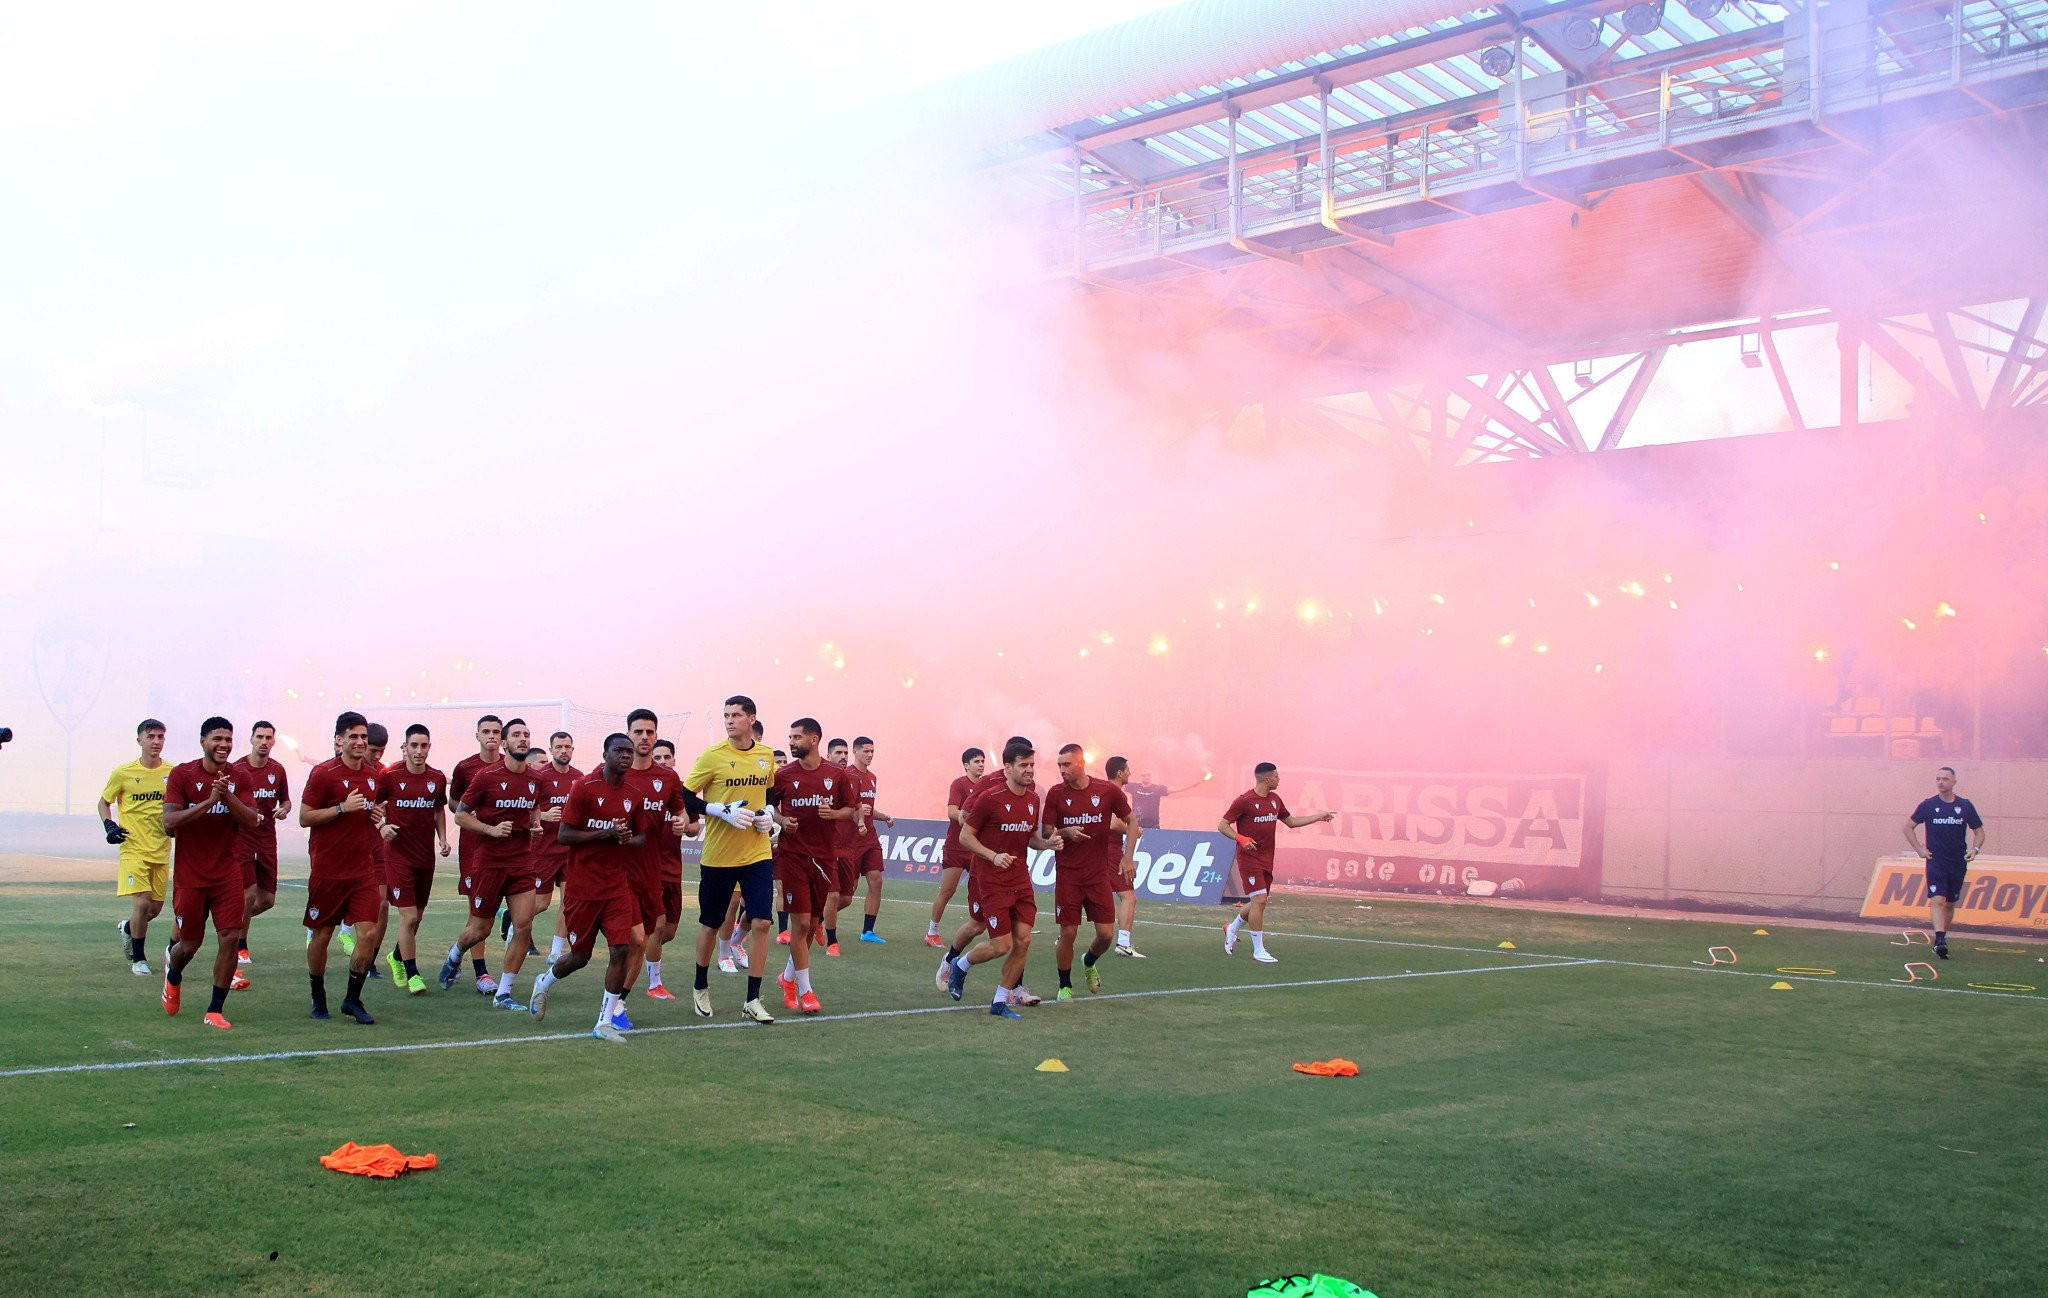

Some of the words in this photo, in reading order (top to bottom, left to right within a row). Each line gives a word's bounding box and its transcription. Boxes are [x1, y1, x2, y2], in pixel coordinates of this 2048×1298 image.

[132, 791, 165, 801] novib
[253, 788, 276, 798] vibet
[550, 794, 569, 804] novi
[1063, 813, 1103, 825] novibet
[1277, 780, 1567, 849] ARISSA
[1932, 816, 1964, 825] novibet
[1326, 856, 1396, 881] gate
[1418, 863, 1480, 885] one
[1200, 870, 1222, 883] 21+
